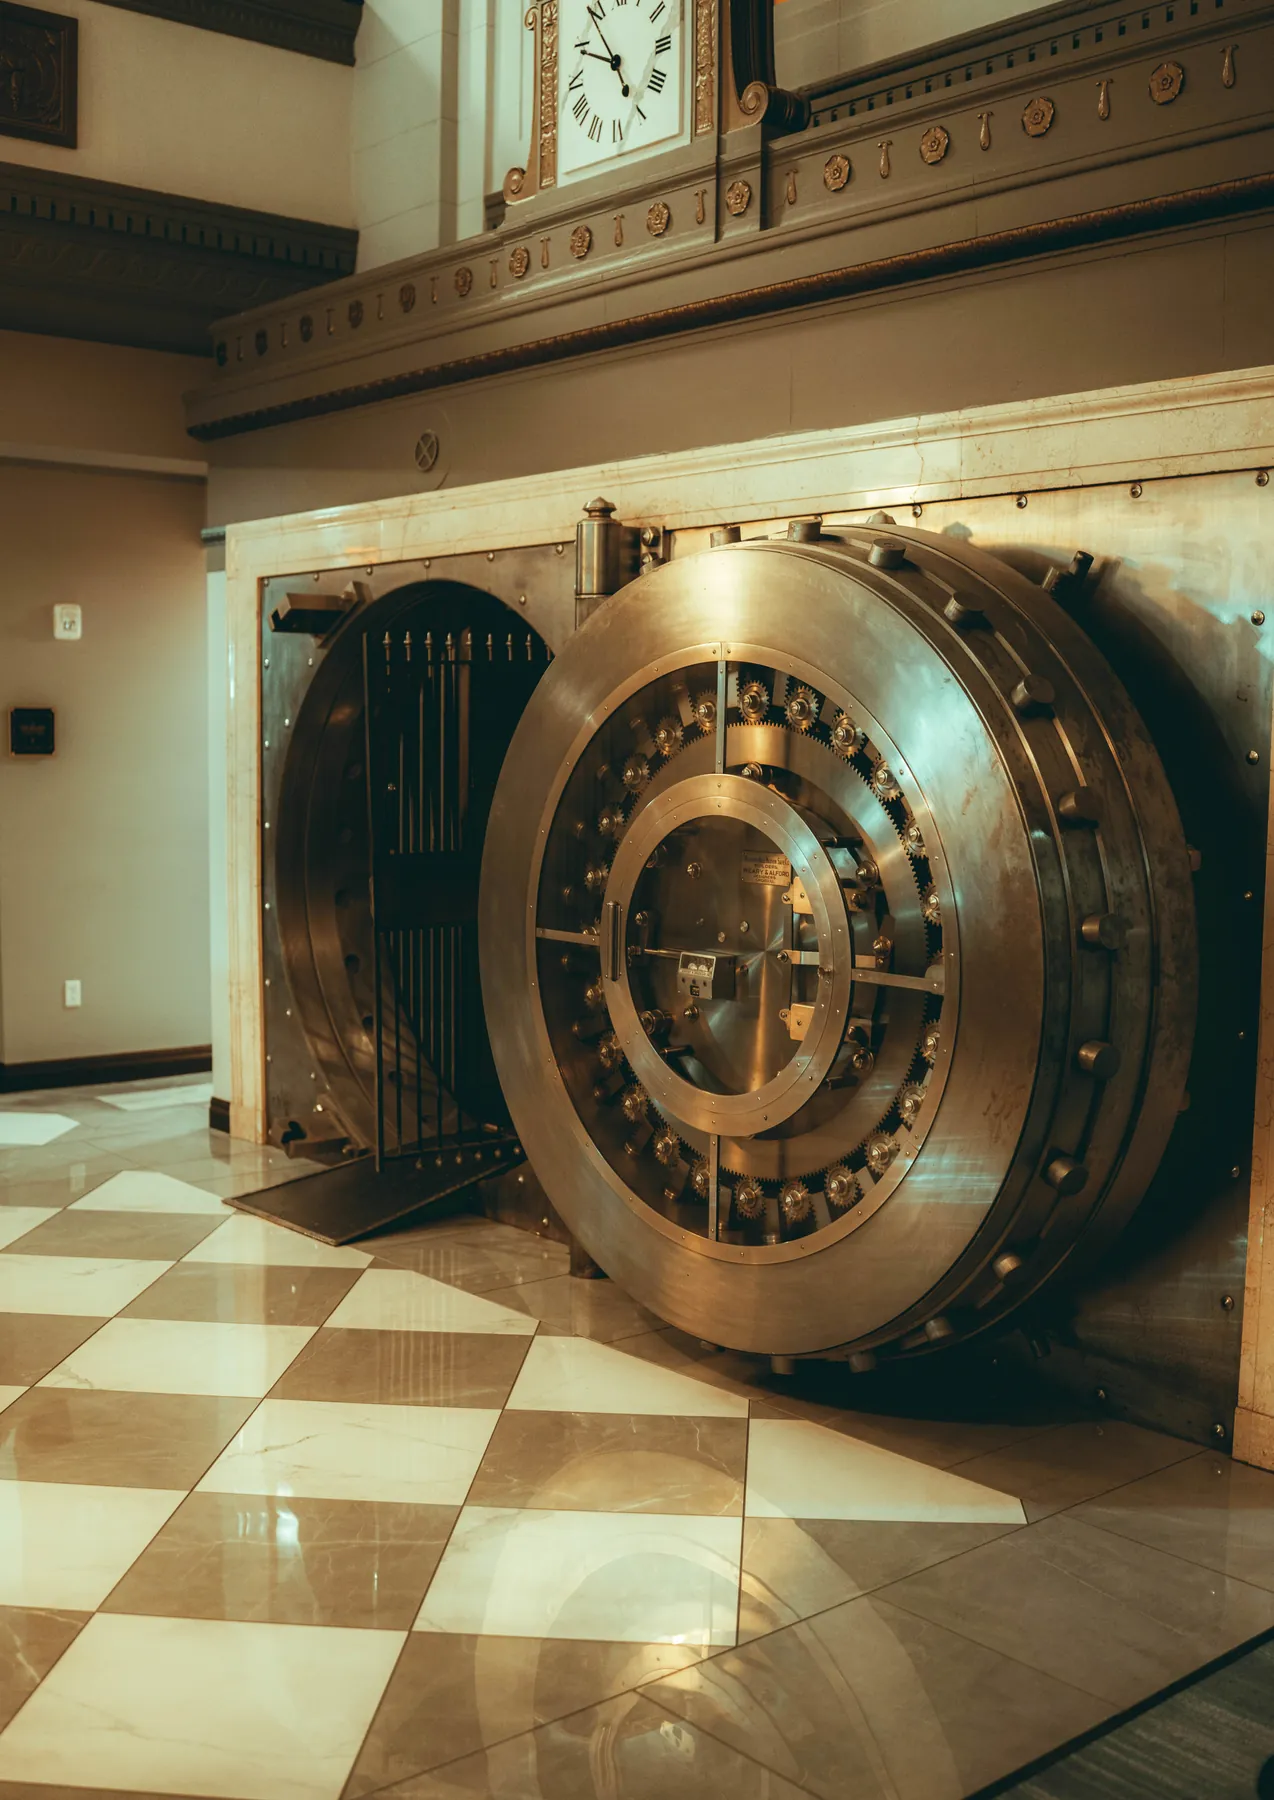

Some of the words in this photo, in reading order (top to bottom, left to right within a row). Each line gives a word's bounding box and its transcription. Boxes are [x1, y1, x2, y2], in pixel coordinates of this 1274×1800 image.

[649, 0, 666, 23] II
[655, 34, 671, 55] III
[647, 68, 667, 94] IIII
